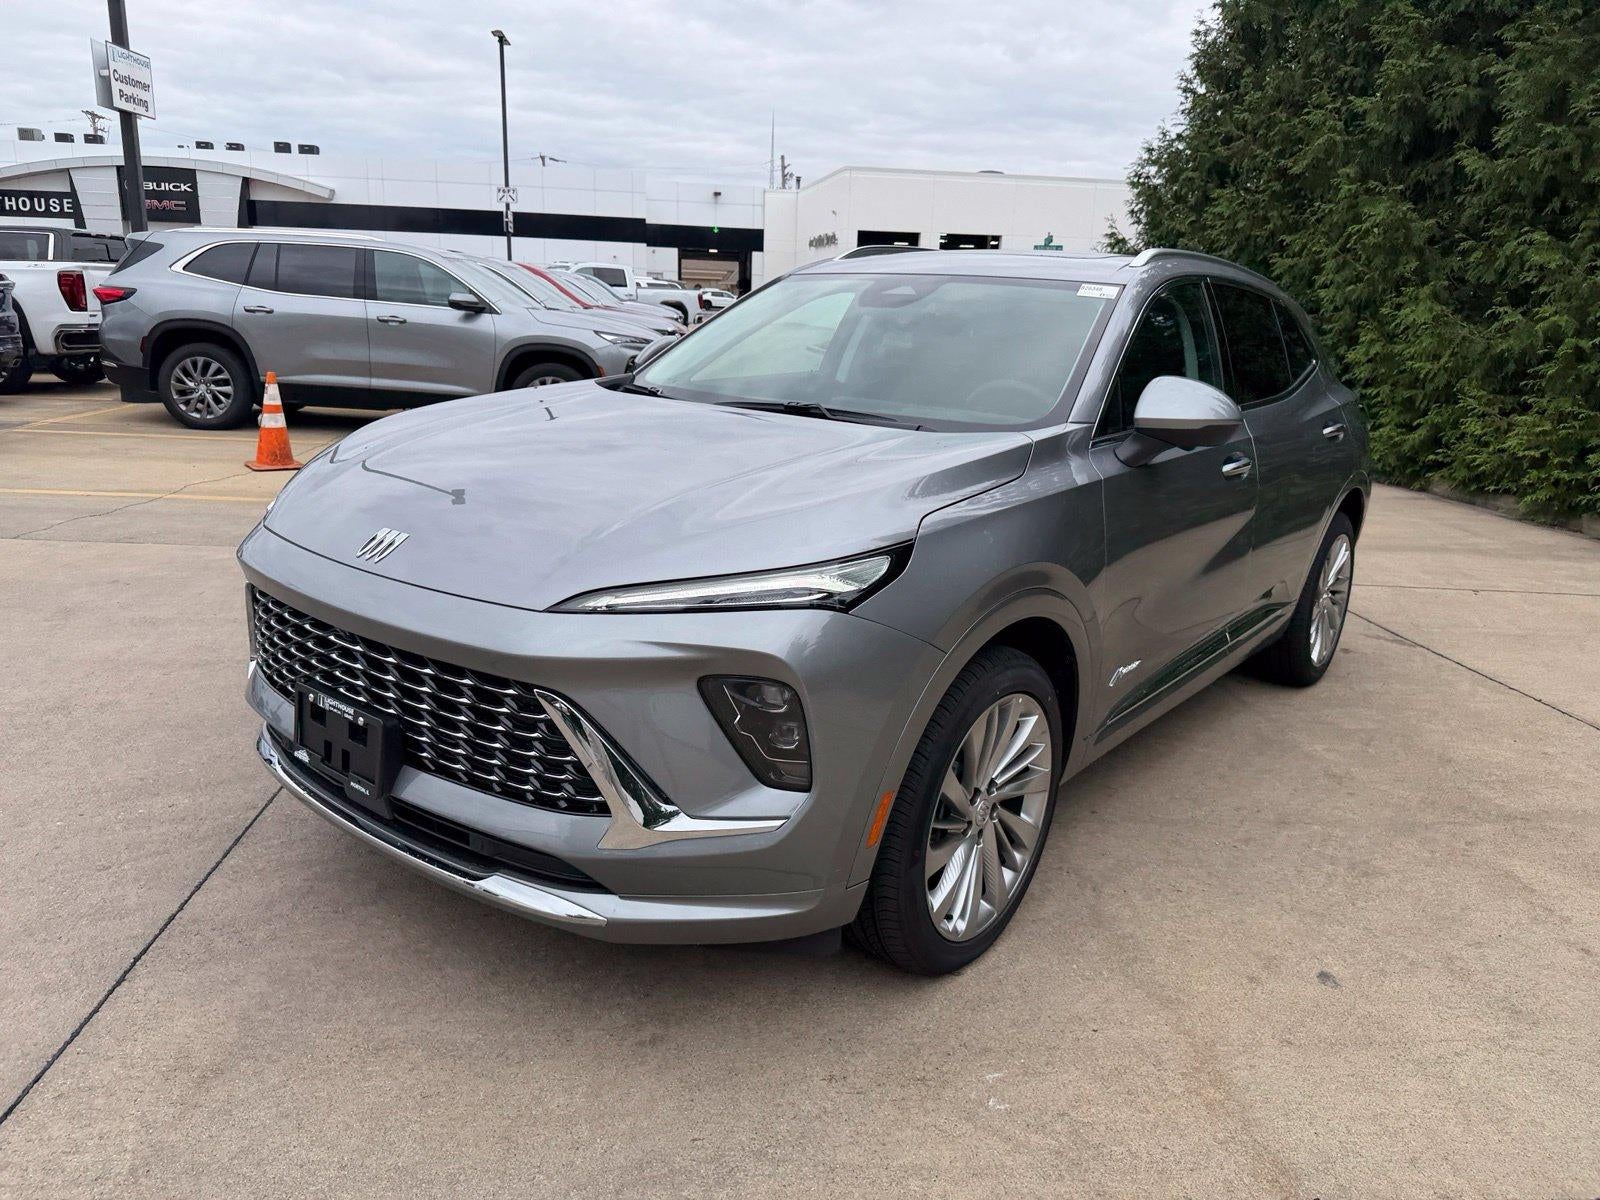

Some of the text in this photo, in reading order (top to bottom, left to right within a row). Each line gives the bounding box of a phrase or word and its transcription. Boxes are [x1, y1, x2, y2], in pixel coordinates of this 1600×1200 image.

[113, 69, 150, 93] Customer
[119, 89, 149, 112] Parking
[143, 181, 193, 192] BUICK
[325, 697, 354, 715] LIGHTHOUSE
